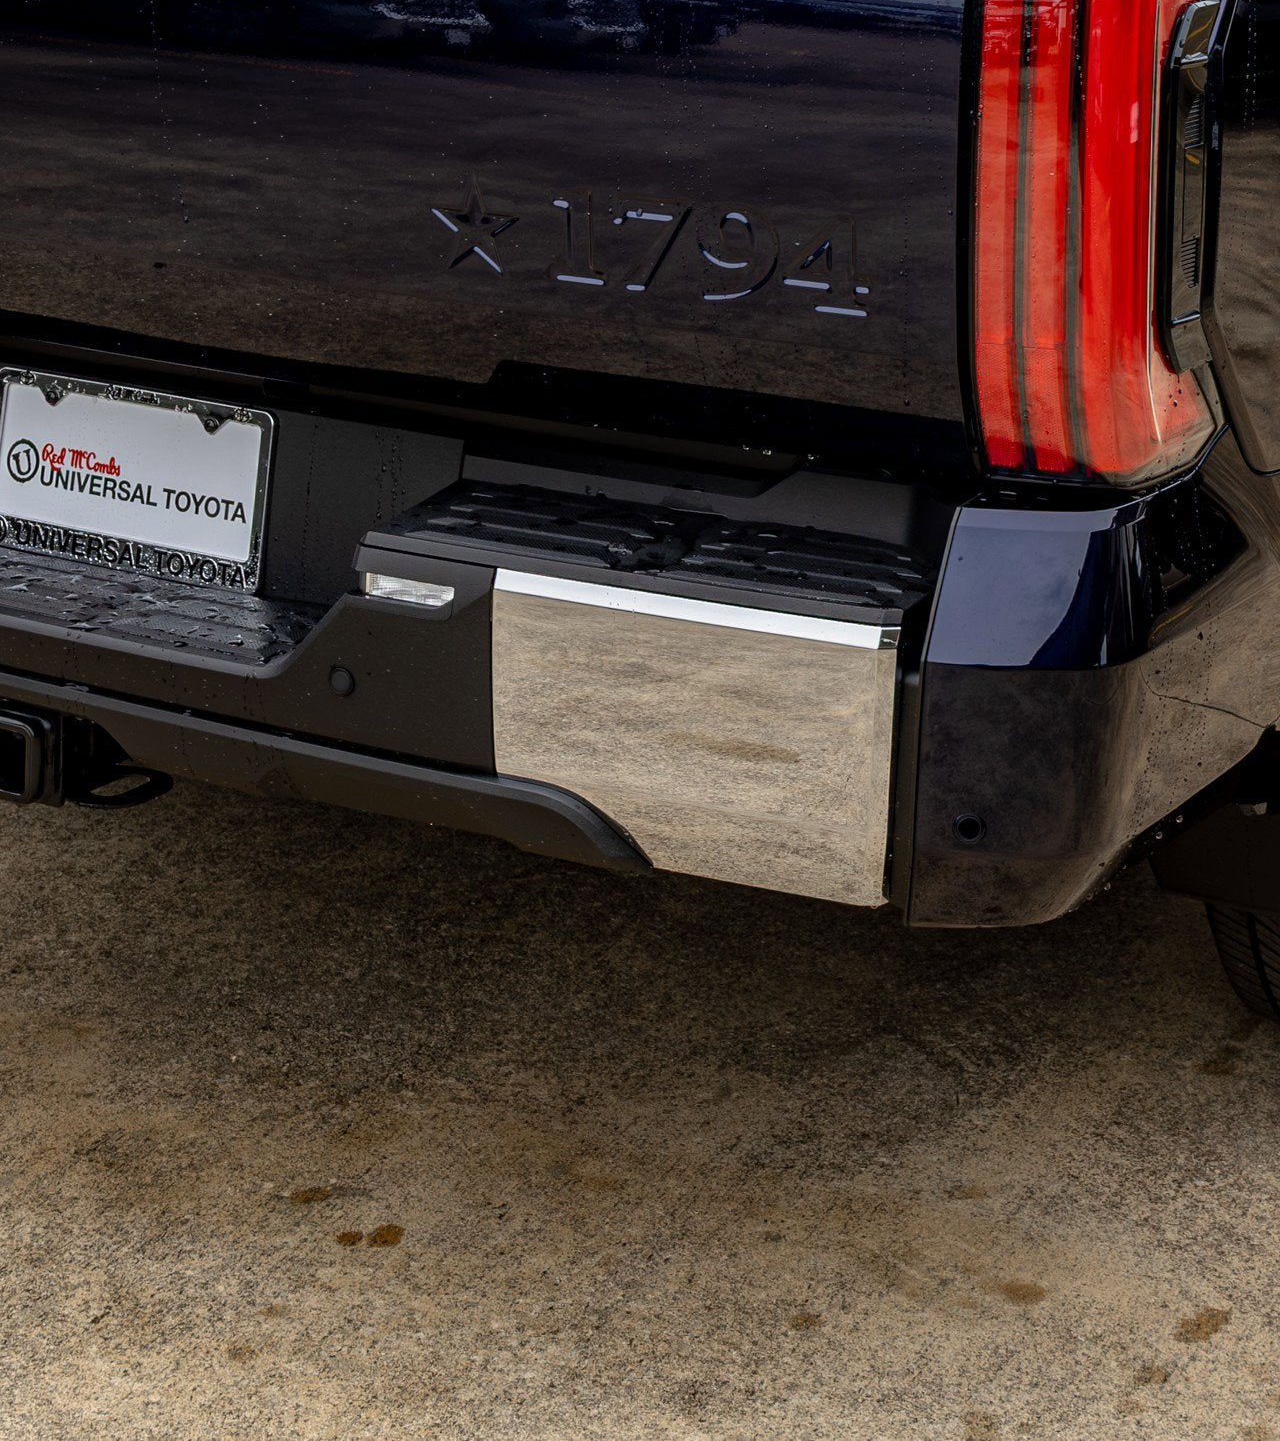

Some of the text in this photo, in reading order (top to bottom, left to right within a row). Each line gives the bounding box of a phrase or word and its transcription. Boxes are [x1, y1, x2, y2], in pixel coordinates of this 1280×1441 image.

[549, 190, 872, 317] 1794
[41, 443, 121, 477] Red McCombs
[40, 465, 247, 525] UNIVERSAL TOYOTA
[15, 519, 250, 589] UNIVERSAL TOYOTA
